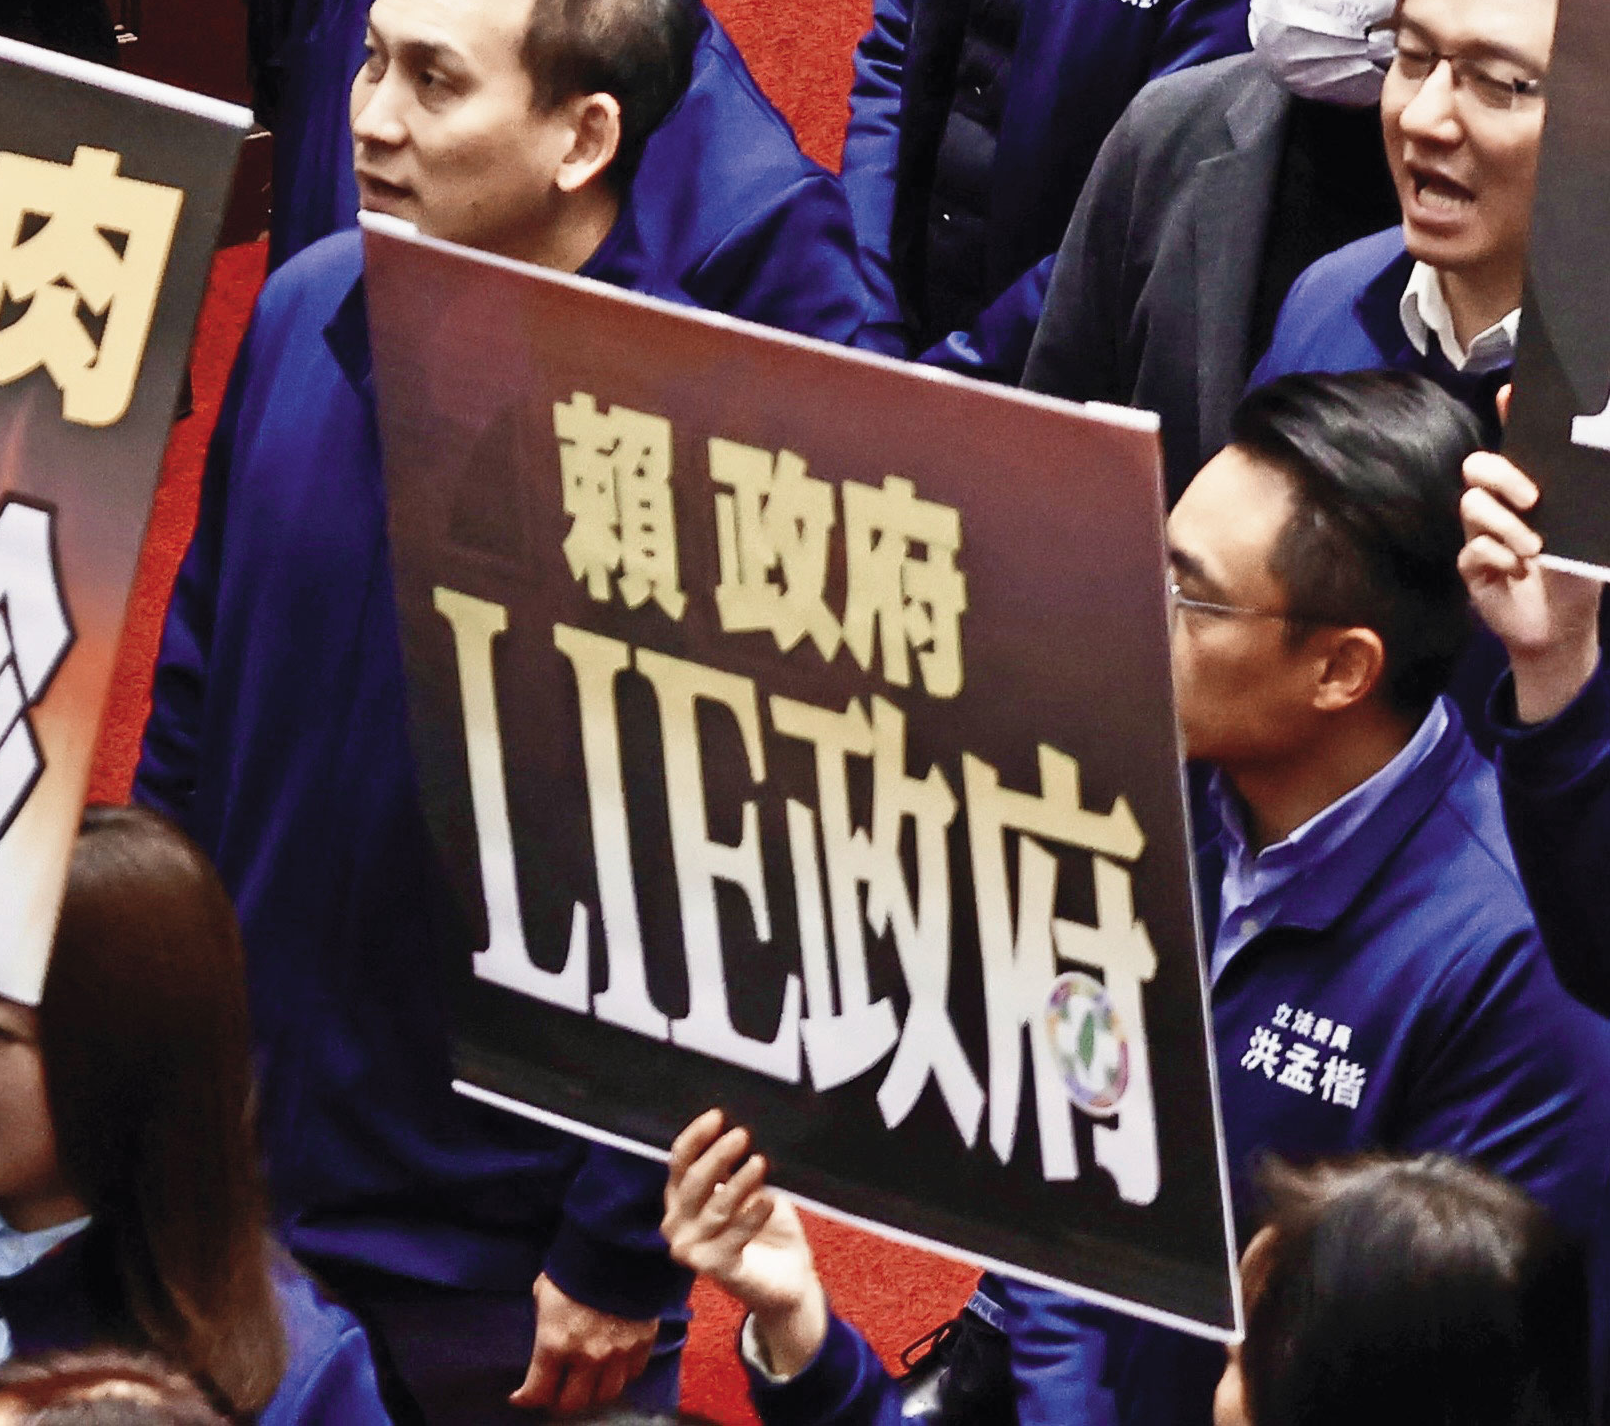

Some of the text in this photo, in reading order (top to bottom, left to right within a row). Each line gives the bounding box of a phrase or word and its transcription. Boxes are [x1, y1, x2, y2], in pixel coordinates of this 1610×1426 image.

[553, 391, 967, 699] 賴 政府
[433, 584, 1160, 1207] LIE政府
[1241, 1026, 1366, 1109] 洪孟楷
[1272, 1003, 1352, 1052] 立法委員
